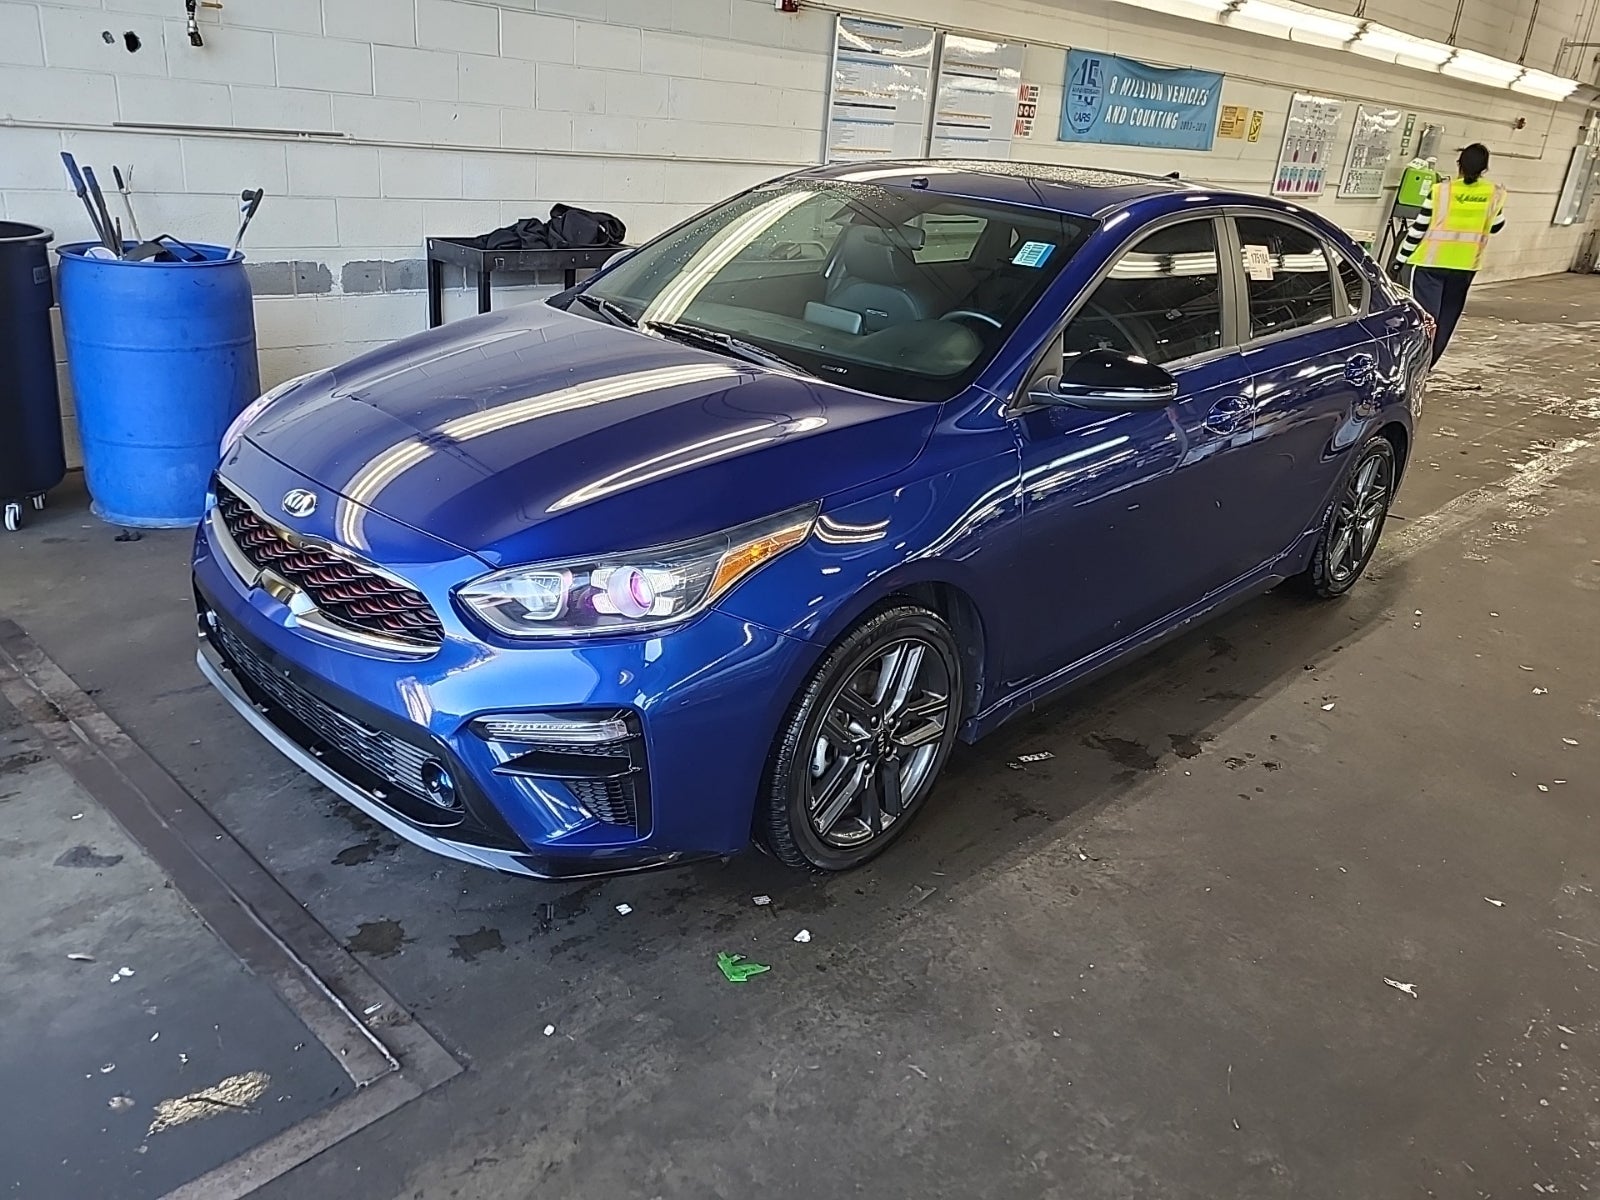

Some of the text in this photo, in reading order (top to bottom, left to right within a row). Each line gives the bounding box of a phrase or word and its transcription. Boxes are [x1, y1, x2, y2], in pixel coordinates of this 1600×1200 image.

[1019, 84, 1029, 101] NO
[1109, 76, 1210, 106] 8 MILLION VEHICLES
[1073, 112, 1091, 122] CARS
[1104, 104, 1127, 124] AND
[1129, 107, 1179, 130] COUNTING
[1014, 119, 1024, 136] NO
[284, 491, 311, 513] KIA
